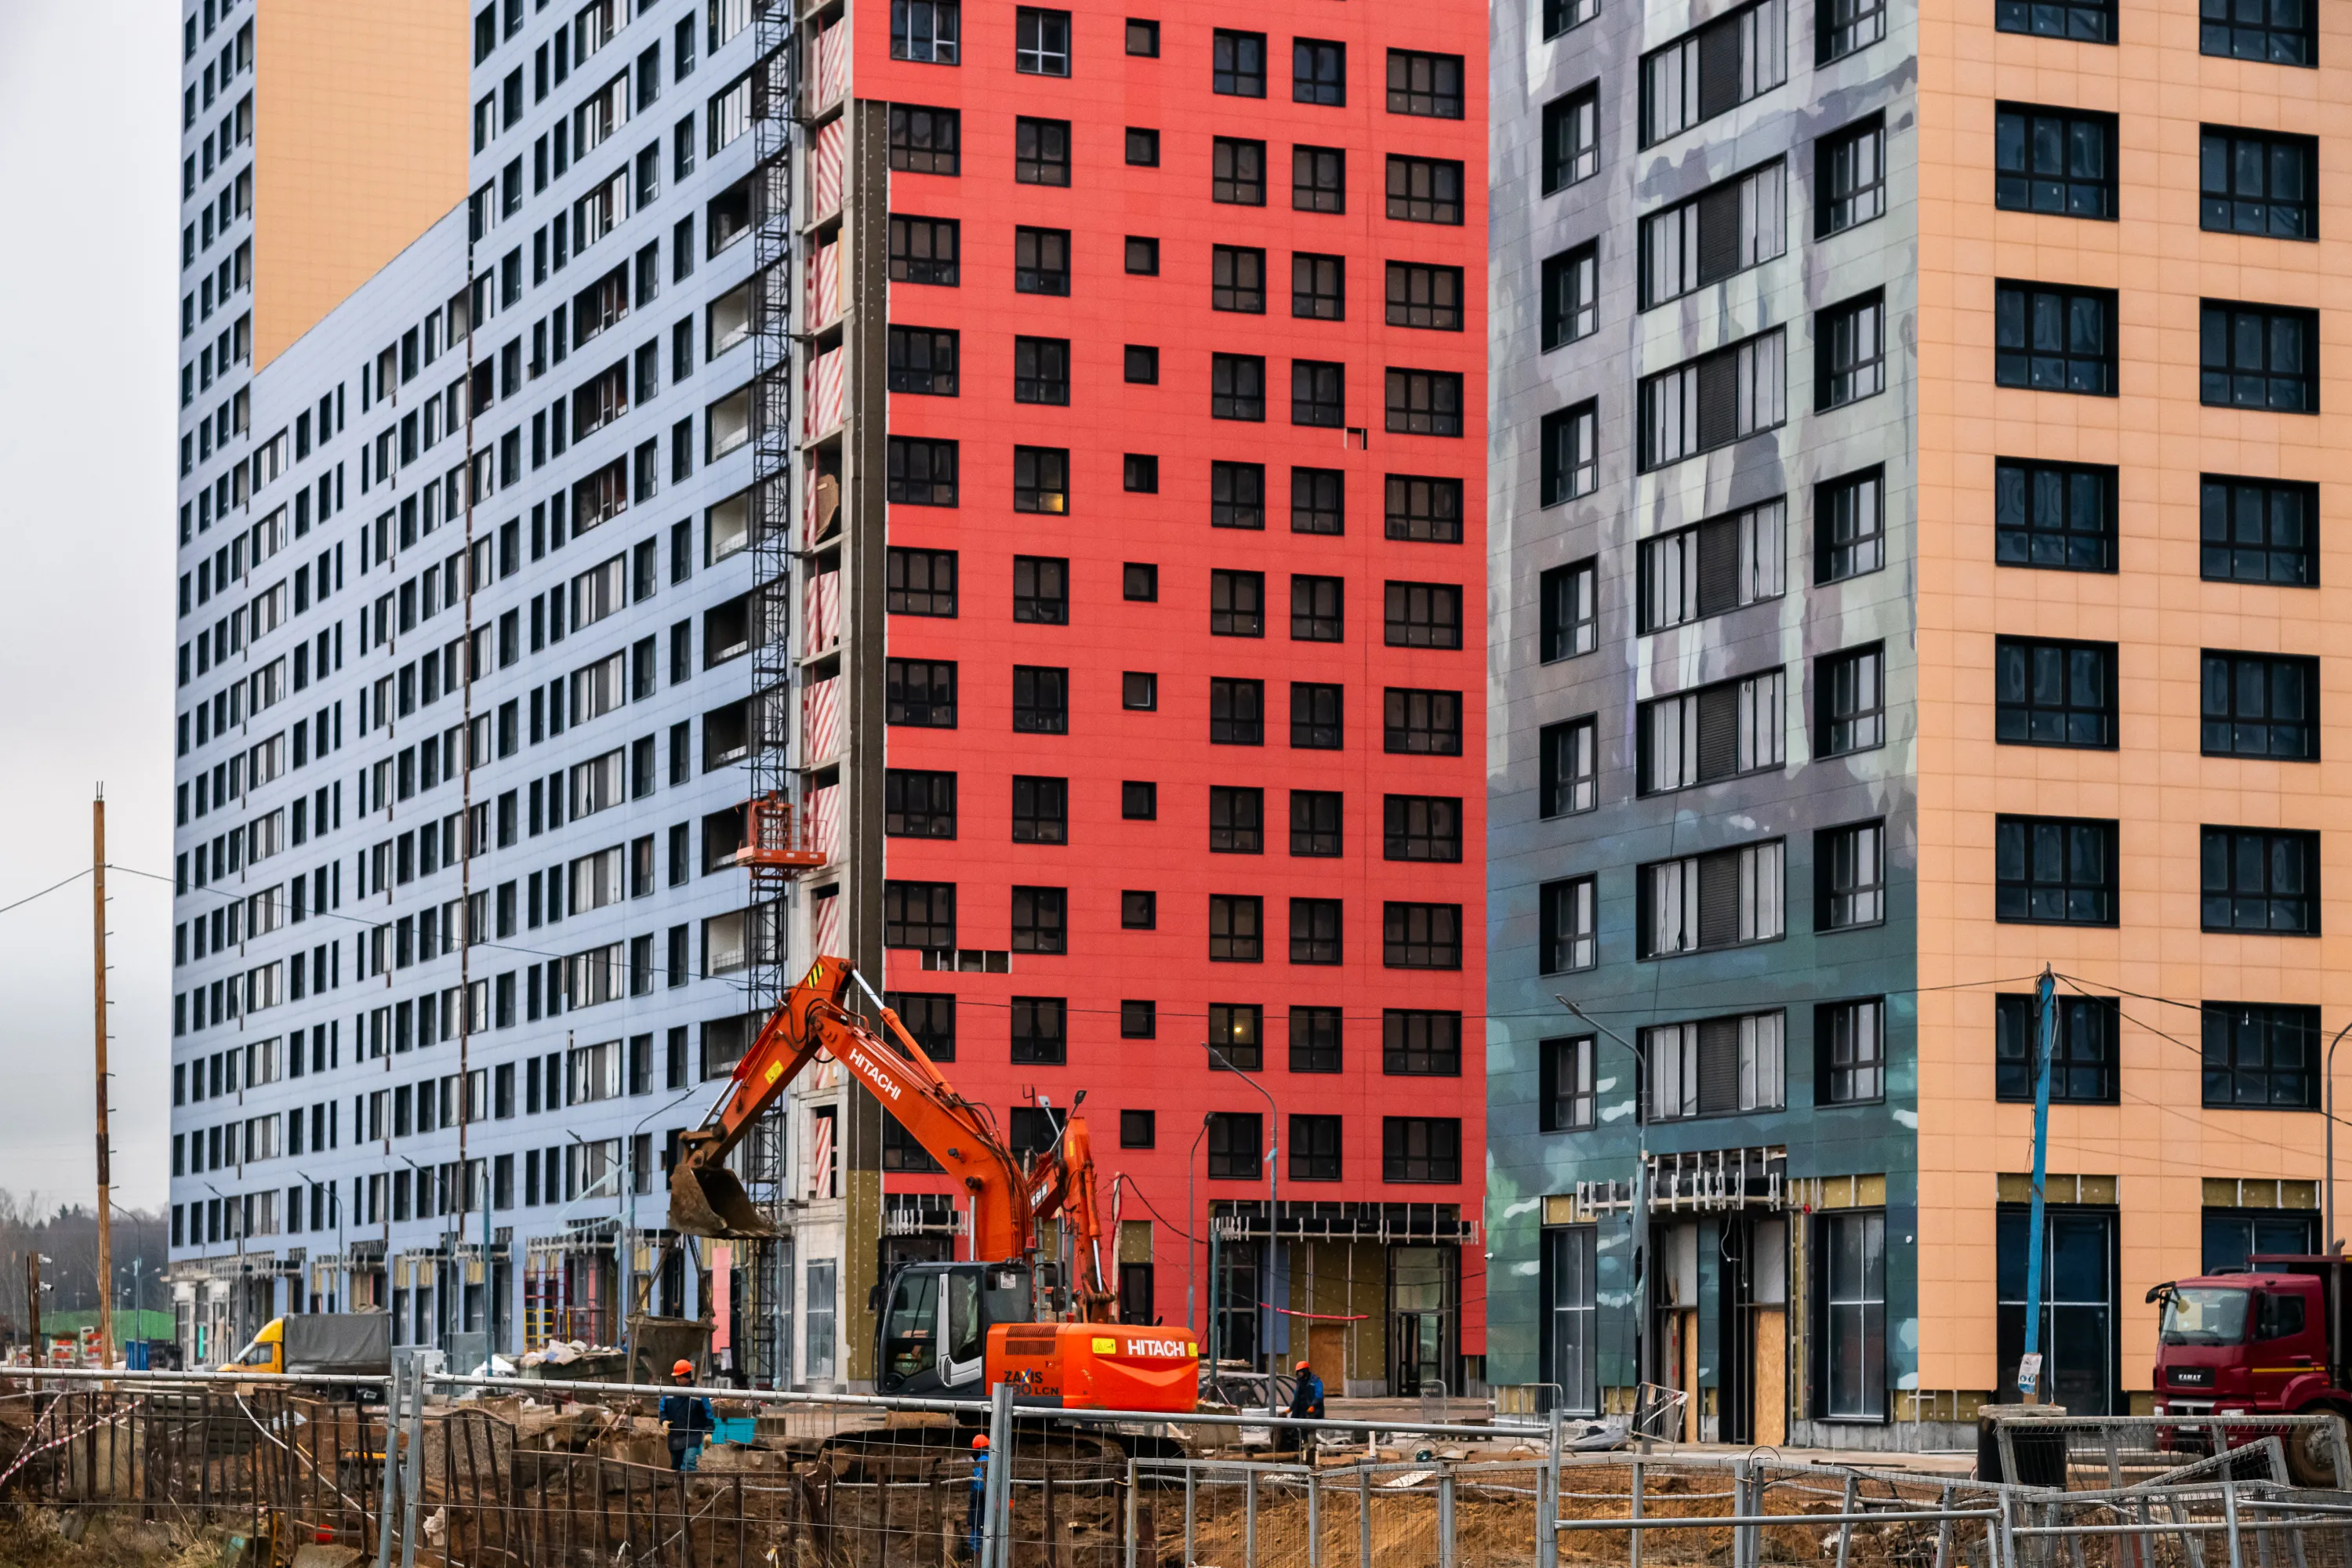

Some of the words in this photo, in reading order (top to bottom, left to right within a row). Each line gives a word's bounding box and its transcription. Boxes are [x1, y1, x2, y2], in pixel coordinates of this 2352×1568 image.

[849, 1048, 902, 1101] HITACHI
[1127, 1339, 1185, 1357] HITACHI
[1004, 1368, 1043, 1384] ZAXIS
[1004, 1383, 1033, 1396] 30
